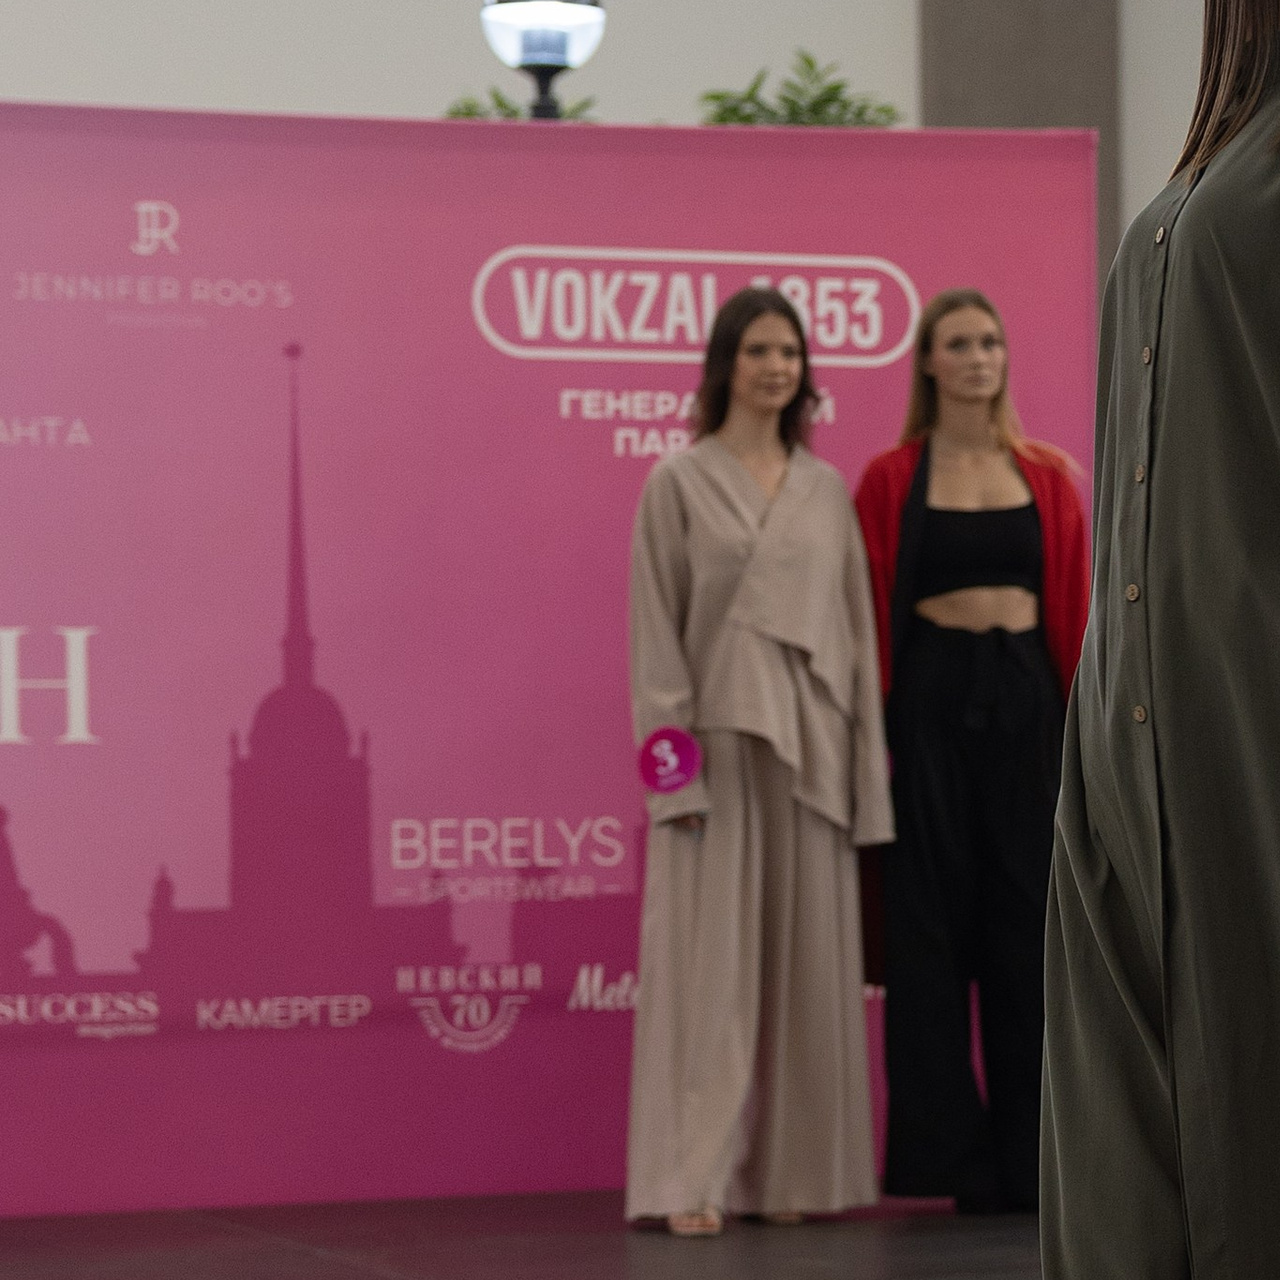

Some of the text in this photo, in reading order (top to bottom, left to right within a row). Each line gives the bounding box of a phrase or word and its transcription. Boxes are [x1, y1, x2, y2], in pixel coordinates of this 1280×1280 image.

[750, 275, 883, 350] 853
[390, 815, 626, 870] BERELYS
[195, 994, 373, 1030] КАМЕРГЕР
